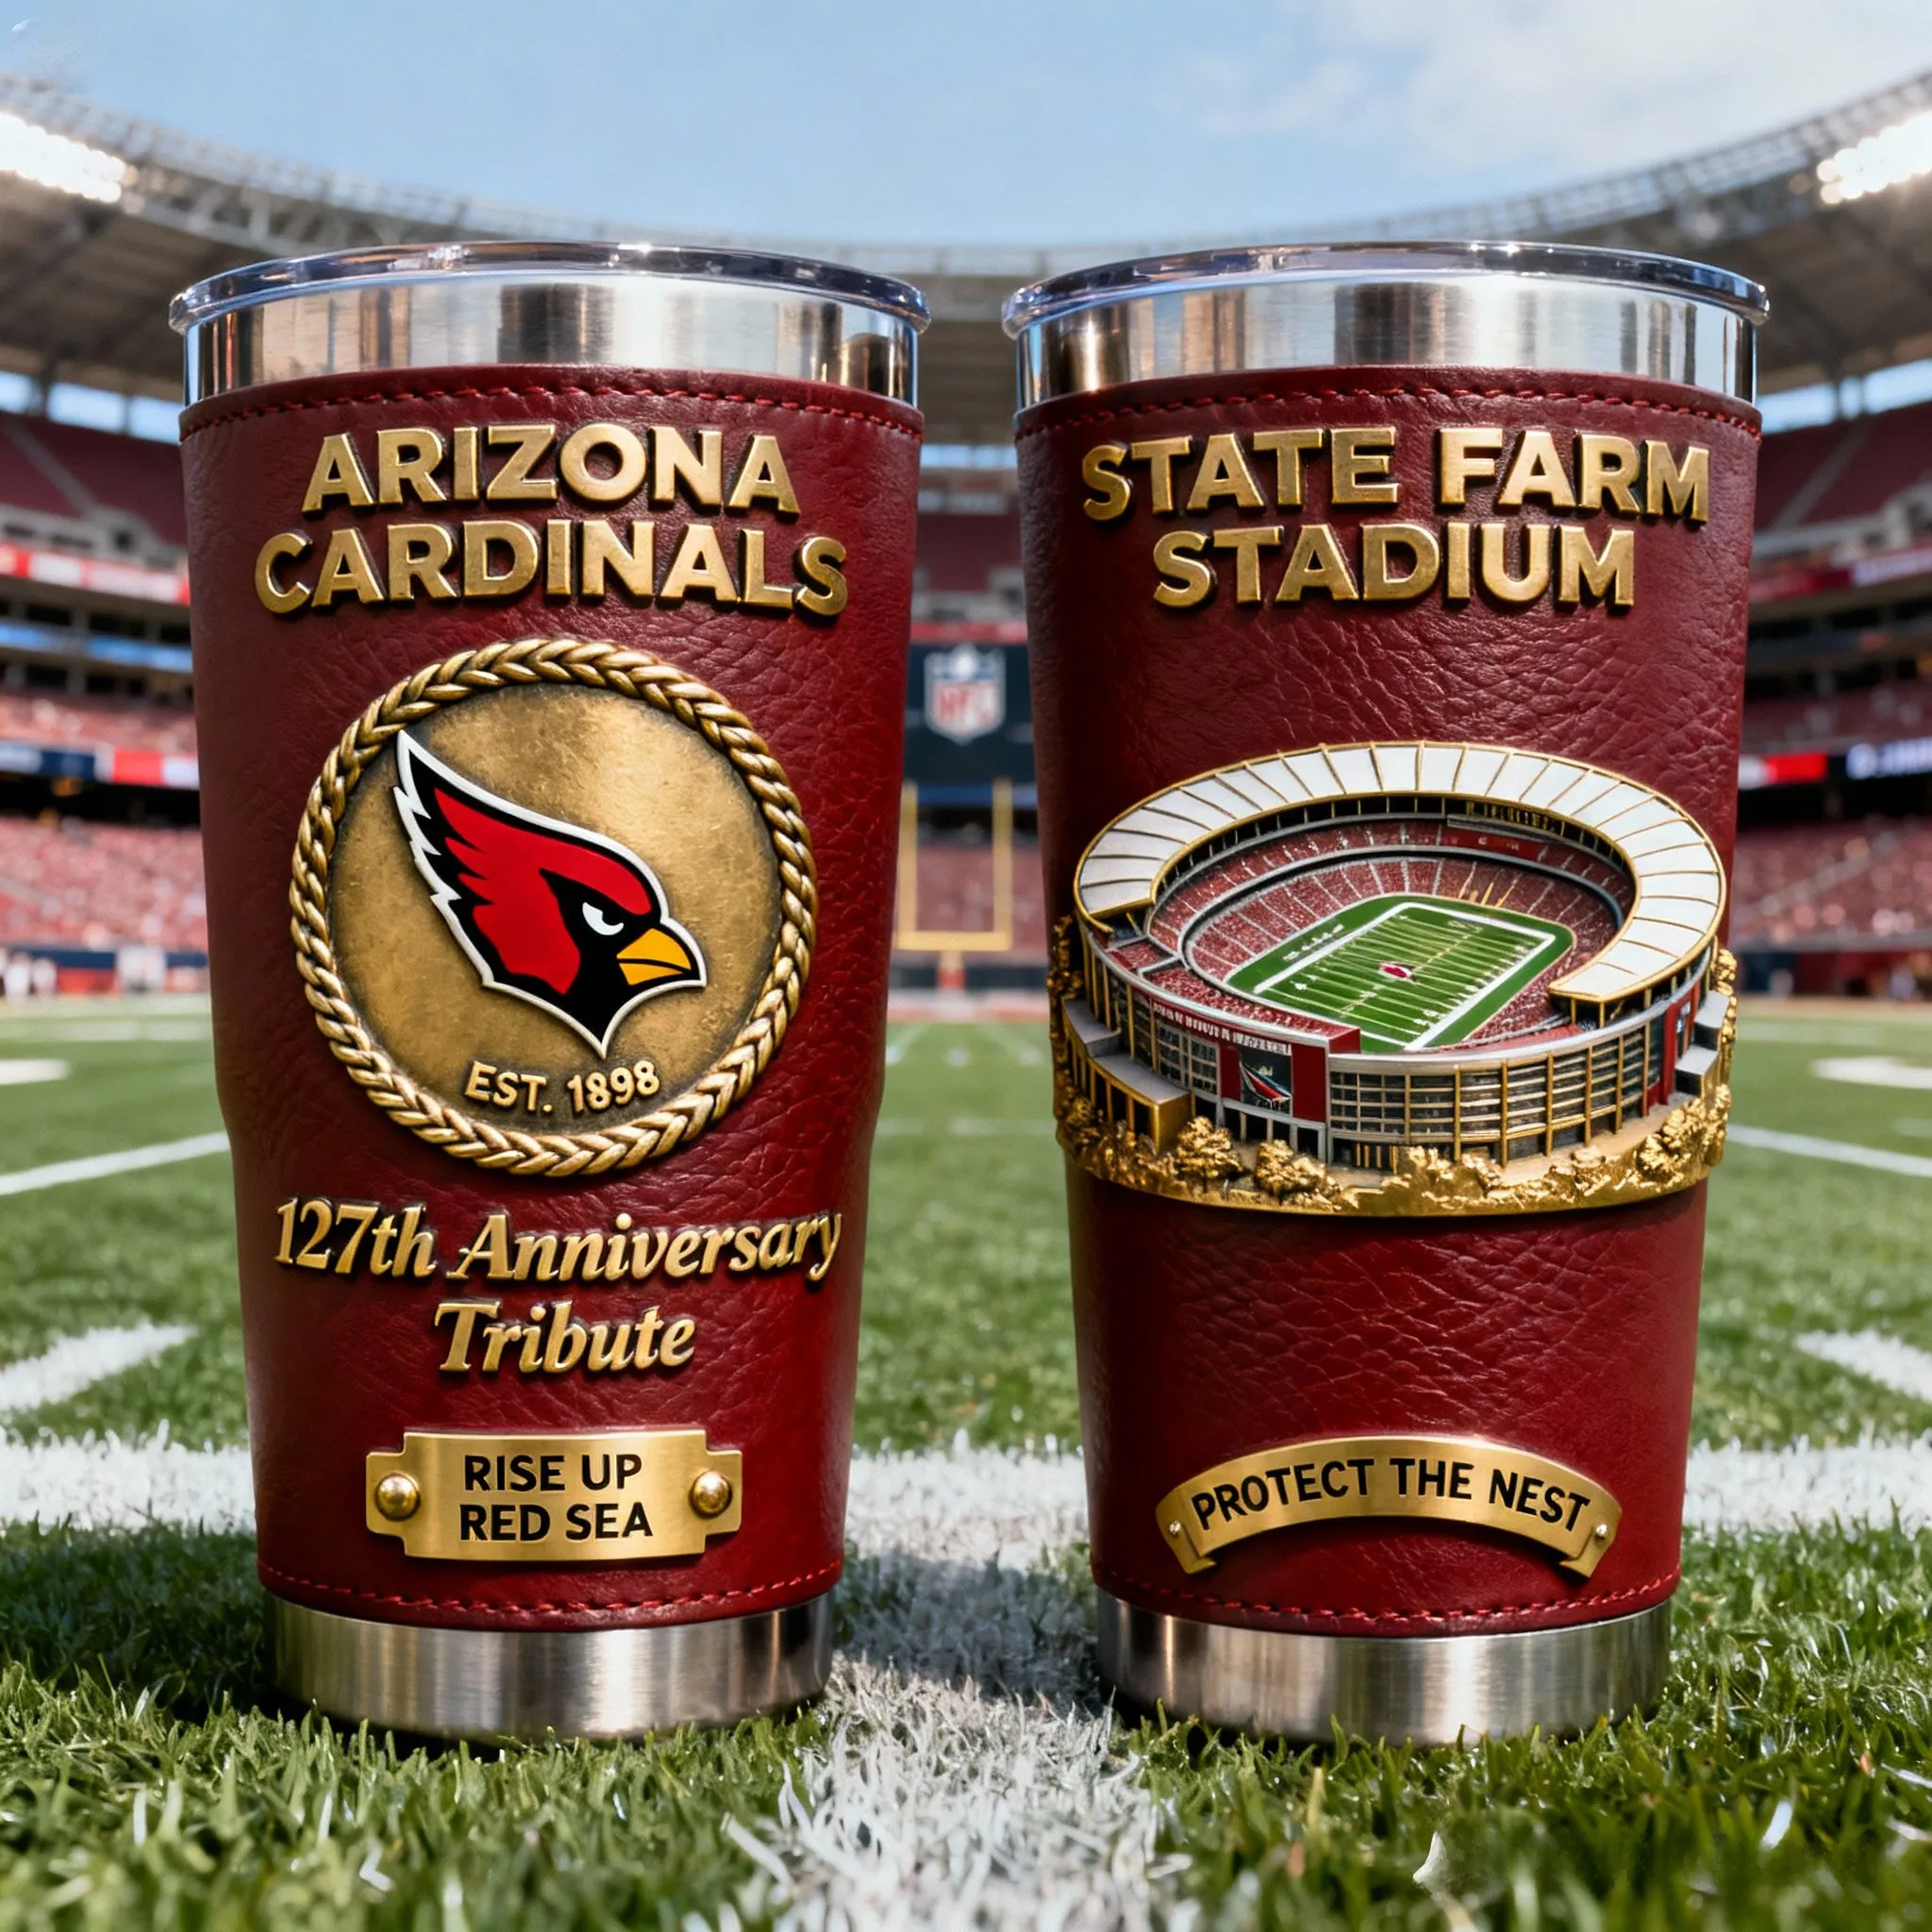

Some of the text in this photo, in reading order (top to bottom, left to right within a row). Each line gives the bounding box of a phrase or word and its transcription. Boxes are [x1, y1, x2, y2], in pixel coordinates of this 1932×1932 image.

[301, 422, 802, 516] ARIZONA
[1080, 425, 1711, 523] STATE FARM
[253, 519, 849, 617] CARDINALS
[1152, 520, 1635, 609] STADIUM
[463, 1059, 660, 1113] EST. 1898
[275, 1196, 844, 1283] 127th Anniversary
[433, 1298, 696, 1374] Tribute
[464, 1453, 642, 1492] RISE UP
[1191, 1457, 1591, 1532] PROTECT THE NEST
[459, 1501, 653, 1541] RED SEA
